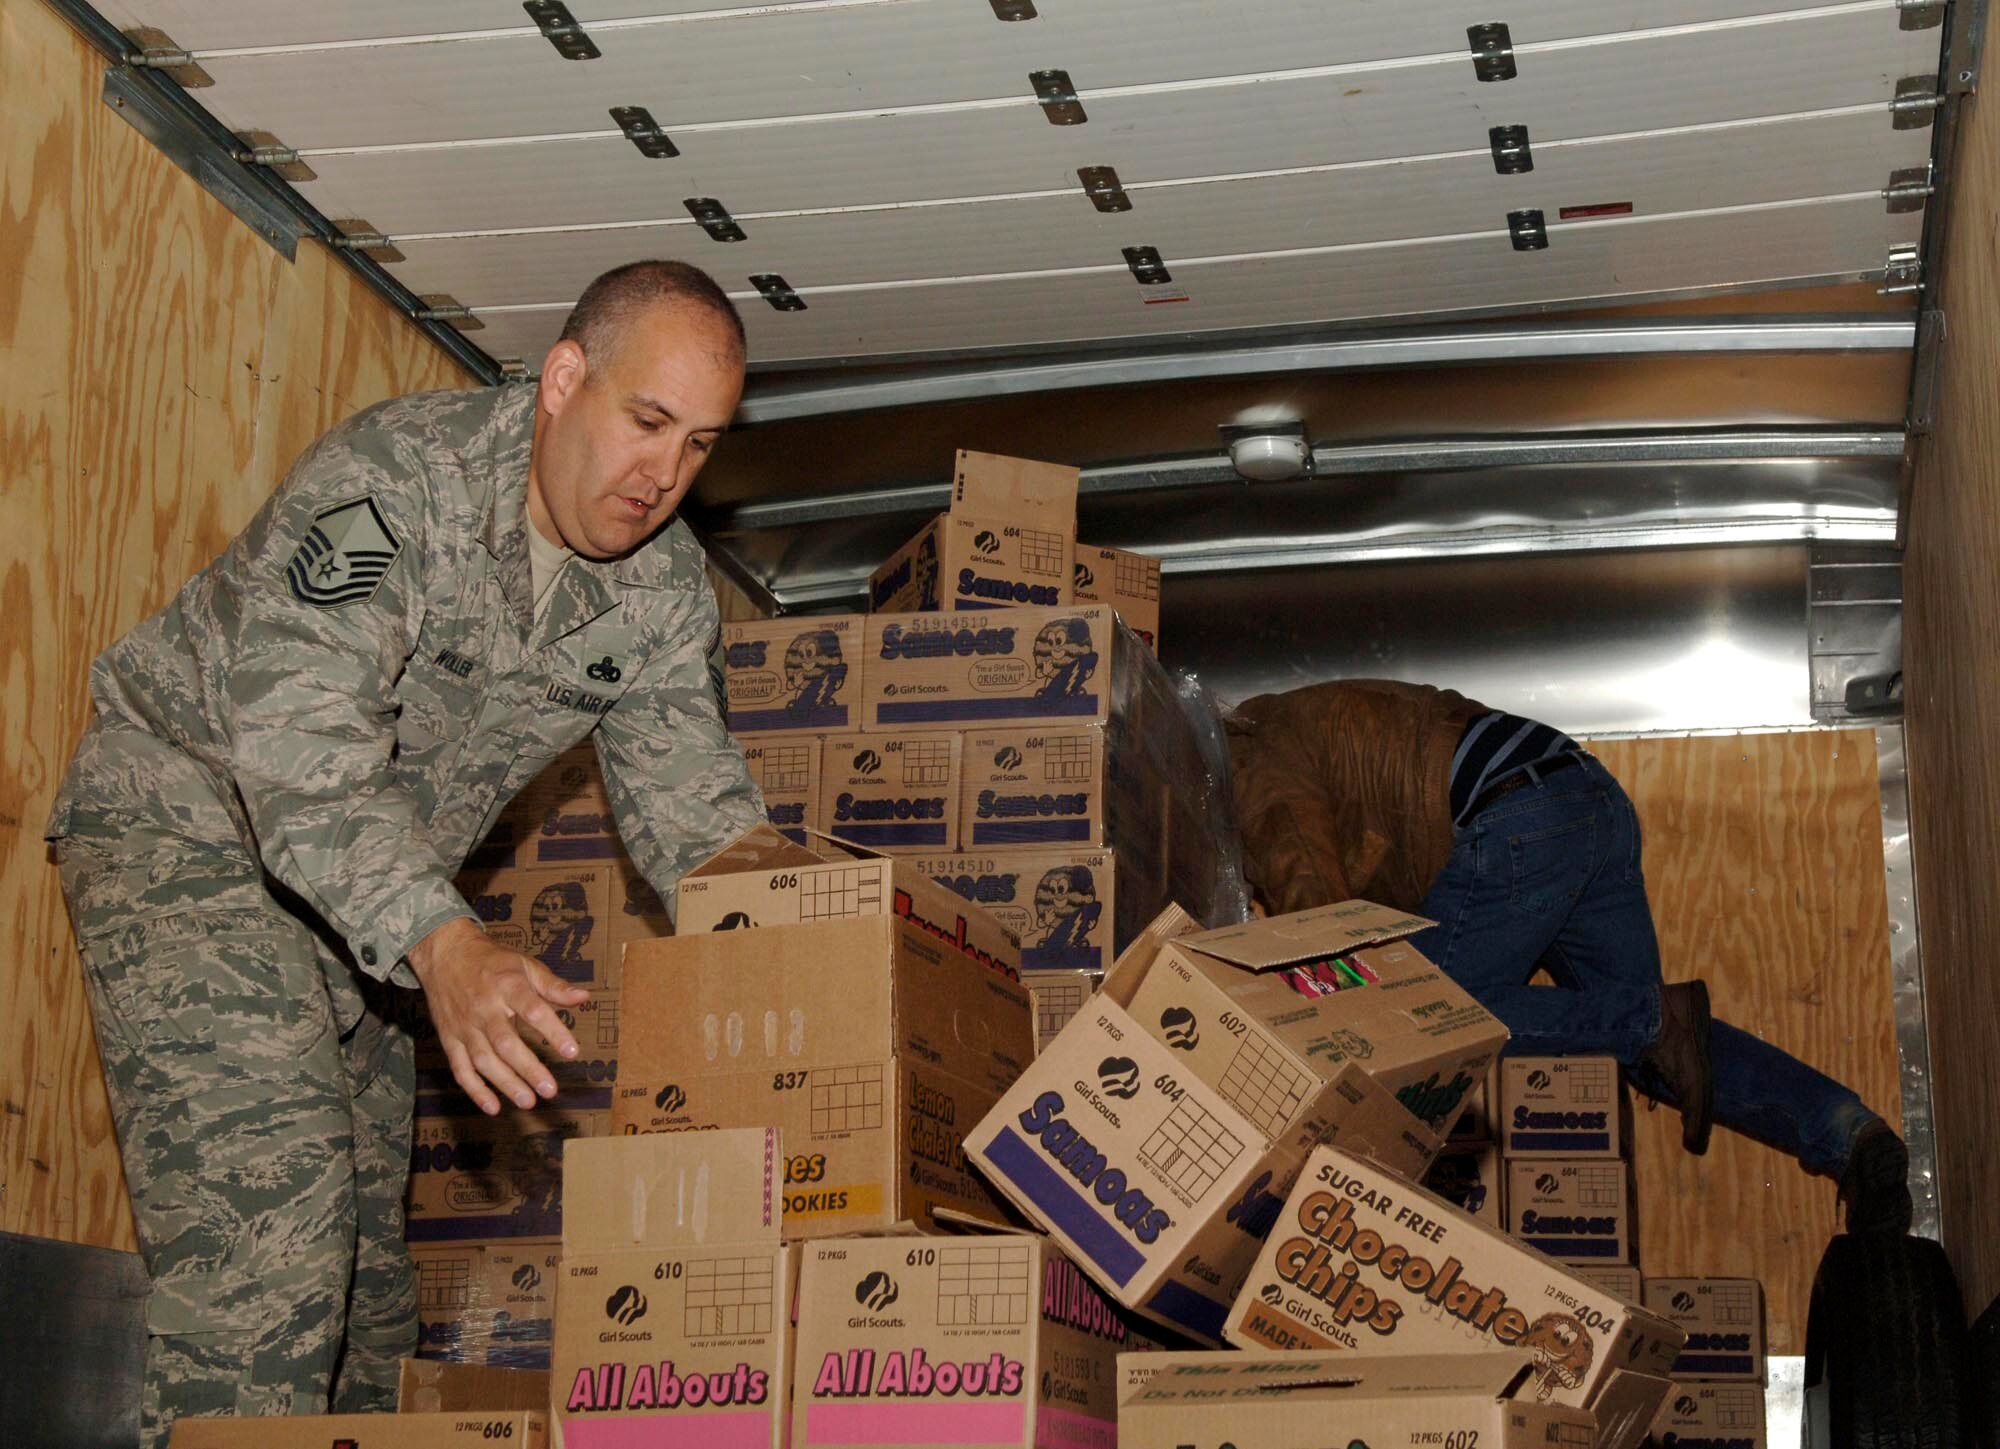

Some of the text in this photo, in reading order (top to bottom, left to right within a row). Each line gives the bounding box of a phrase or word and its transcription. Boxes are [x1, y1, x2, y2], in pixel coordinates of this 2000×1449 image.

[1003, 526, 1020, 538] 604
[1100, 550, 1115, 560] 606
[958, 568, 1059, 606] Samoas
[1084, 610, 1100, 620] 604
[834, 622, 849, 631] 604
[911, 617, 988, 631] 51914510
[880, 624, 1015, 660] Samoas
[900, 685, 916, 694] Girl
[547, 683, 573, 707] U.S.
[574, 694, 601, 714] AIR
[885, 741, 903, 752] 604
[1026, 738, 1044, 748] 604
[745, 749, 762, 759] 604
[834, 793, 945, 821] Samoas
[976, 790, 1088, 818] Samoas
[917, 860, 995, 874] 51914510
[1087, 857, 1104, 867] 604
[580, 874, 595, 883] 604
[770, 874, 797, 890] 606
[682, 882, 708, 893] 12 PKGS
[1168, 959, 1193, 984] 12 PKGS
[1097, 1016, 1124, 1042] 12 PKGS
[1219, 1011, 1246, 1039] 602
[1554, 1064, 1569, 1073] 604
[773, 1071, 808, 1091] 837
[1154, 1074, 1185, 1103] 604
[910, 1072, 954, 1126] Lemon
[1074, 1080, 1118, 1126] Girl Scouts
[651, 1118, 665, 1126] Girl
[1513, 1105, 1607, 1129] Samoas
[910, 1116, 951, 1168] Chalet
[1018, 1091, 1171, 1244] Samoas
[1561, 1167, 1577, 1177] 604
[1316, 1165, 1388, 1216] SUGAR
[1394, 1207, 1447, 1245] FREE
[1521, 1209, 1617, 1235] Samoas
[818, 1251, 847, 1260] 12 PKGS
[906, 1249, 935, 1266] 610
[571, 1266, 598, 1276] 12 PKGS
[655, 1262, 682, 1279] 610
[1298, 1191, 1530, 1347] Chocolate
[1043, 1260, 1068, 1326] All
[1275, 1236, 1404, 1336] Chips
[1544, 1285, 1578, 1309] 12 PKGS
[848, 1317, 867, 1328] Girl
[1286, 1299, 1358, 1348] Girl Scouts
[1574, 1305, 1615, 1335] 404
[599, 1330, 652, 1342] Girl Scouts
[1249, 1315, 1298, 1350] MADE
[812, 1349, 875, 1397] All
[876, 1348, 1024, 1397] Abouts
[566, 1360, 769, 1412] All Abouts
[1143, 1391, 1176, 1399] Do
[1183, 1389, 1226, 1398] Not
[456, 1422, 483, 1433] 12 PKGS
[483, 1422, 513, 1439] 606
[1411, 1432, 1443, 1444] 12 PKGS
[1445, 1431, 1478, 1449] 602
